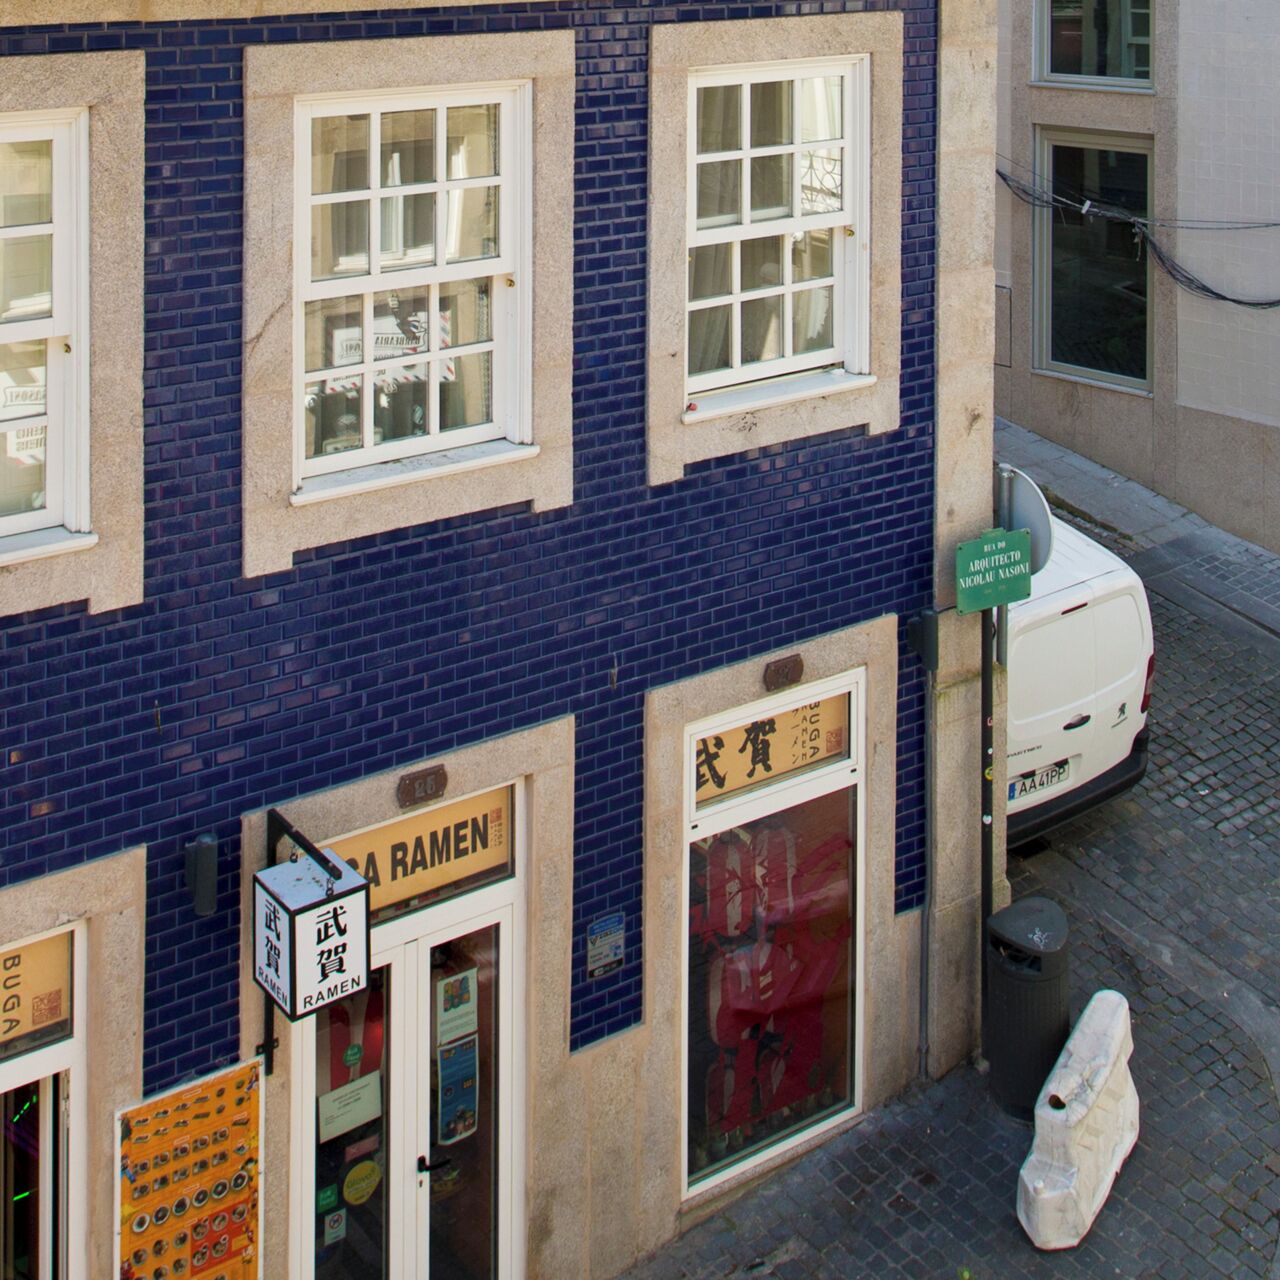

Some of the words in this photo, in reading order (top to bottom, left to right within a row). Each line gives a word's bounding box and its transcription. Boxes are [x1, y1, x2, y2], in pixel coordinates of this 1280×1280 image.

[968, 550, 1021, 573] ARQUITECTO
[983, 544, 996, 552] RUA
[997, 541, 1006, 549] DO
[959, 570, 996, 589] NICOLAU
[999, 562, 1029, 580] NASONI
[391, 812, 489, 882] RAMEN
[265, 898, 281, 980] 武賀
[316, 904, 348, 985] 武賀
[2, 954, 21, 1035] BUGA
[258, 965, 288, 1007] RAMEN
[303, 974, 361, 1009] RAMEN
